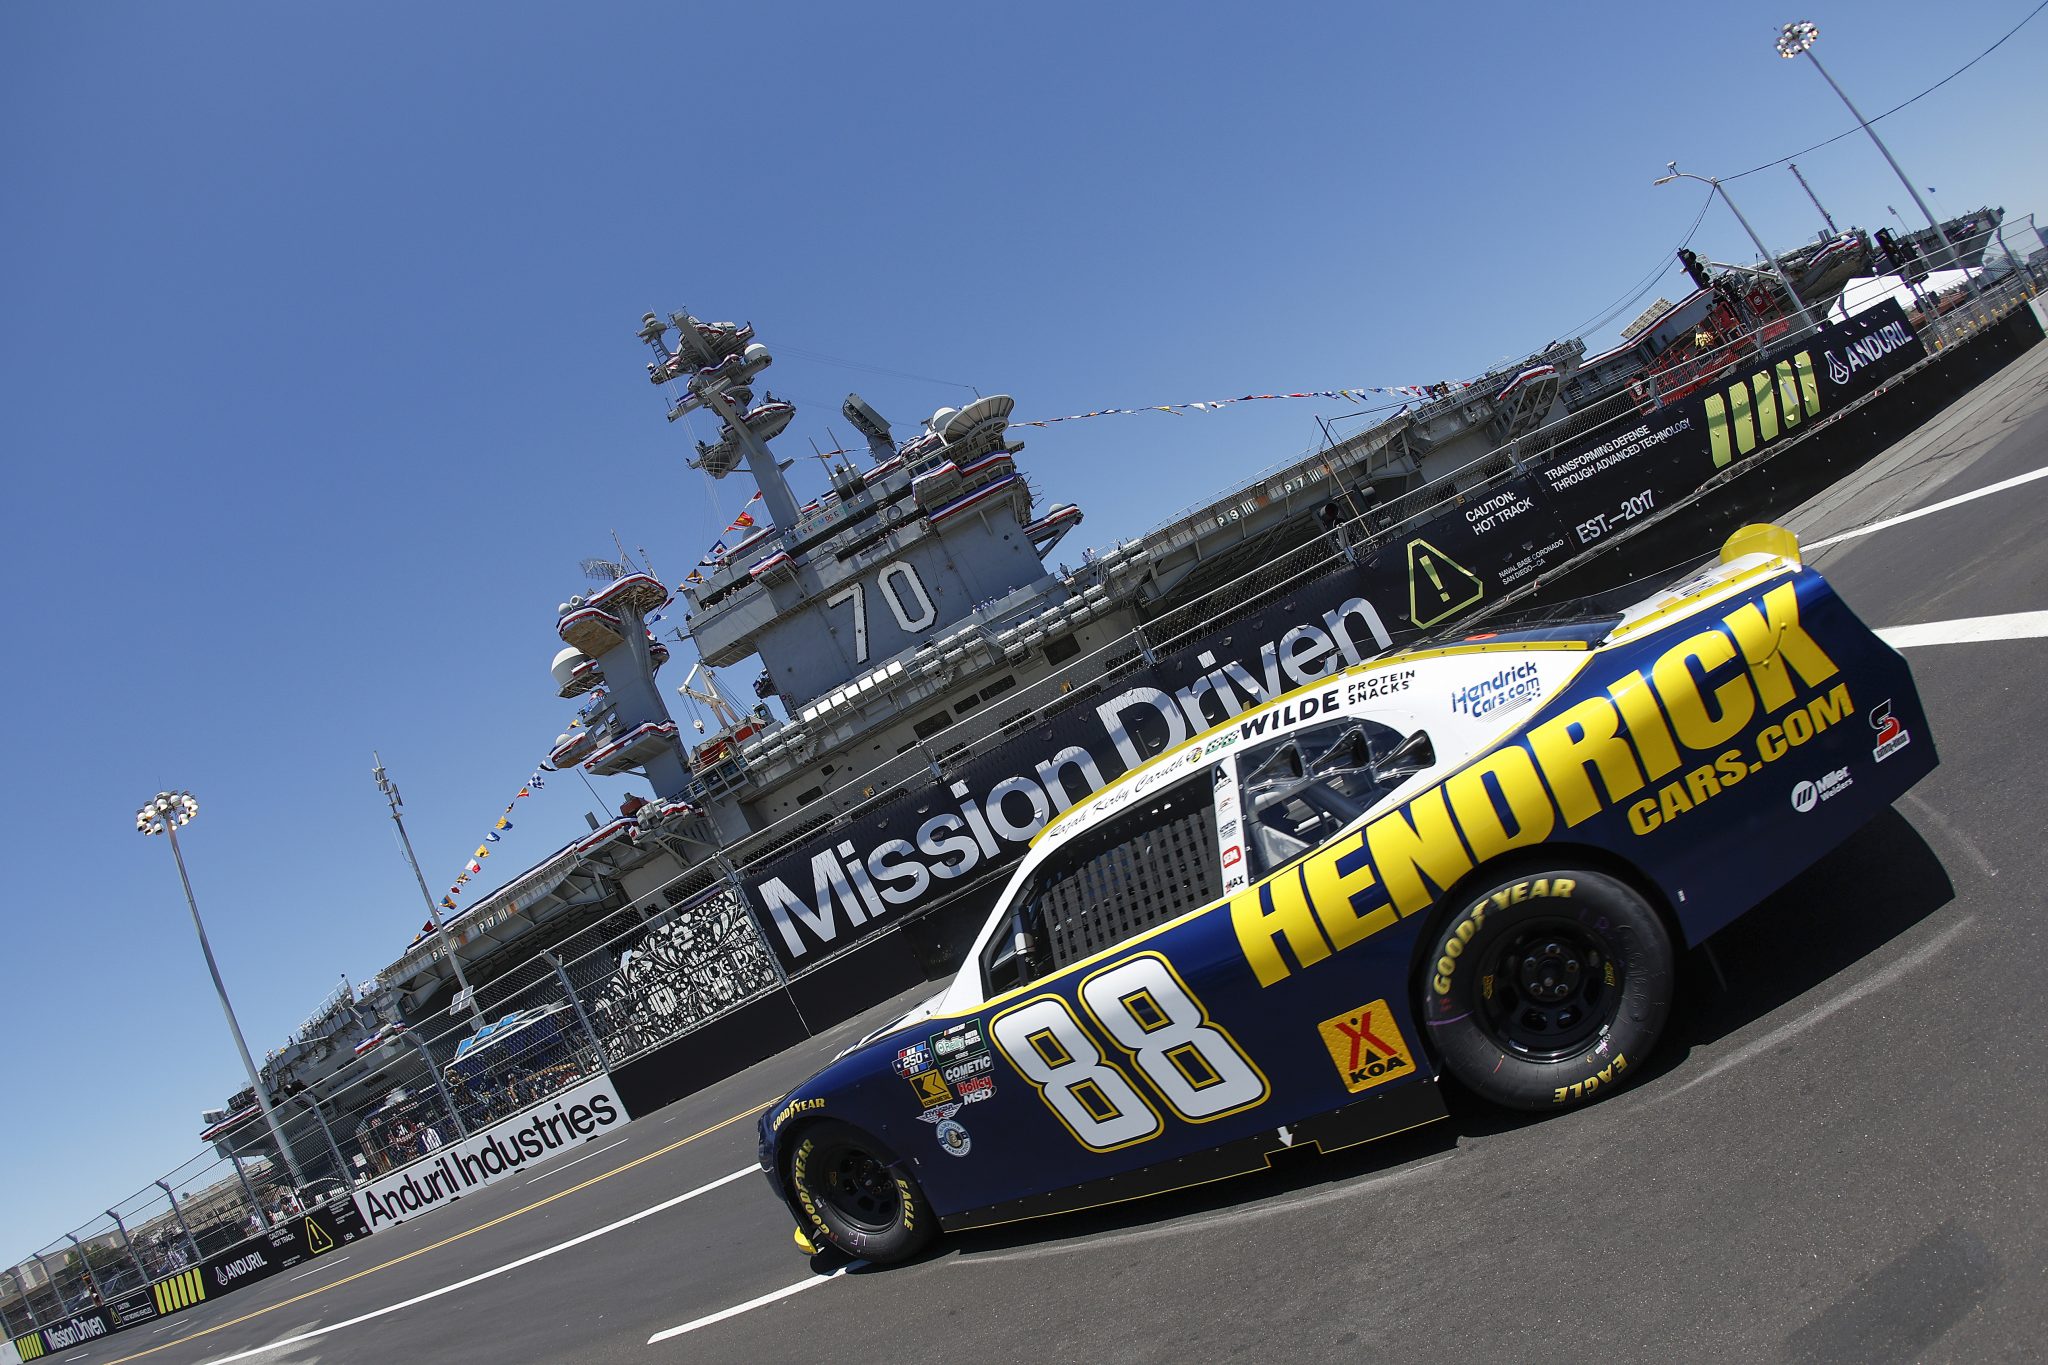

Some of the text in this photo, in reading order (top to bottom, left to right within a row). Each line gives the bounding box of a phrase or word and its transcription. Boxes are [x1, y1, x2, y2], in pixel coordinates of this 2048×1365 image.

[1845, 320, 1913, 373] ANDURIL
[1544, 424, 1651, 481] TRANSFORMING DEFENSE
[1551, 418, 1692, 493] THROUGH ADVANCED TECHNOLOGY
[1465, 491, 1517, 522] CAUTION:
[1472, 496, 1534, 536] HOT TRACK
[1498, 539, 1565, 579] NAVAL BASE CORONADO
[1502, 575, 1516, 585] SAN
[826, 560, 939, 664] 70
[1348, 669, 1416, 693] PROTEIN
[1348, 680, 1410, 705] SNACKS
[1451, 661, 1538, 714] Hendrick
[1472, 677, 1541, 718] Cars.com
[1240, 688, 1341, 741] WILDE
[758, 597, 1394, 958] Mission Driven
[1627, 682, 1855, 836] CARS.COM
[1048, 756, 1185, 840] Rajah Kirby Caruth
[1229, 580, 1840, 989] HENDRICK
[1816, 765, 1850, 794] Miller
[1820, 777, 1854, 802] Welders
[1433, 878, 1577, 996] GOODYEAR
[902, 1053, 923, 1069] 250
[964, 1036, 981, 1047] PARTS
[989, 950, 1272, 1153] 88
[945, 1054, 991, 1081] COMETIC
[956, 1075, 993, 1097] Holley
[1349, 1056, 1409, 1085] KOA
[1553, 1052, 1629, 1104] EAGLE
[772, 1098, 826, 1132] GOODYEAR
[963, 1088, 993, 1106] MSD
[365, 1093, 618, 1227] Anduril Industries
[794, 1138, 831, 1235] GOODYEAR
[896, 1178, 915, 1232] EAGLE
[272, 1233, 296, 1248] HOT TRACK
[343, 1231, 356, 1241] USA
[225, 1251, 268, 1280] ANDURIL
[44, 1314, 107, 1351] Mission Driven
